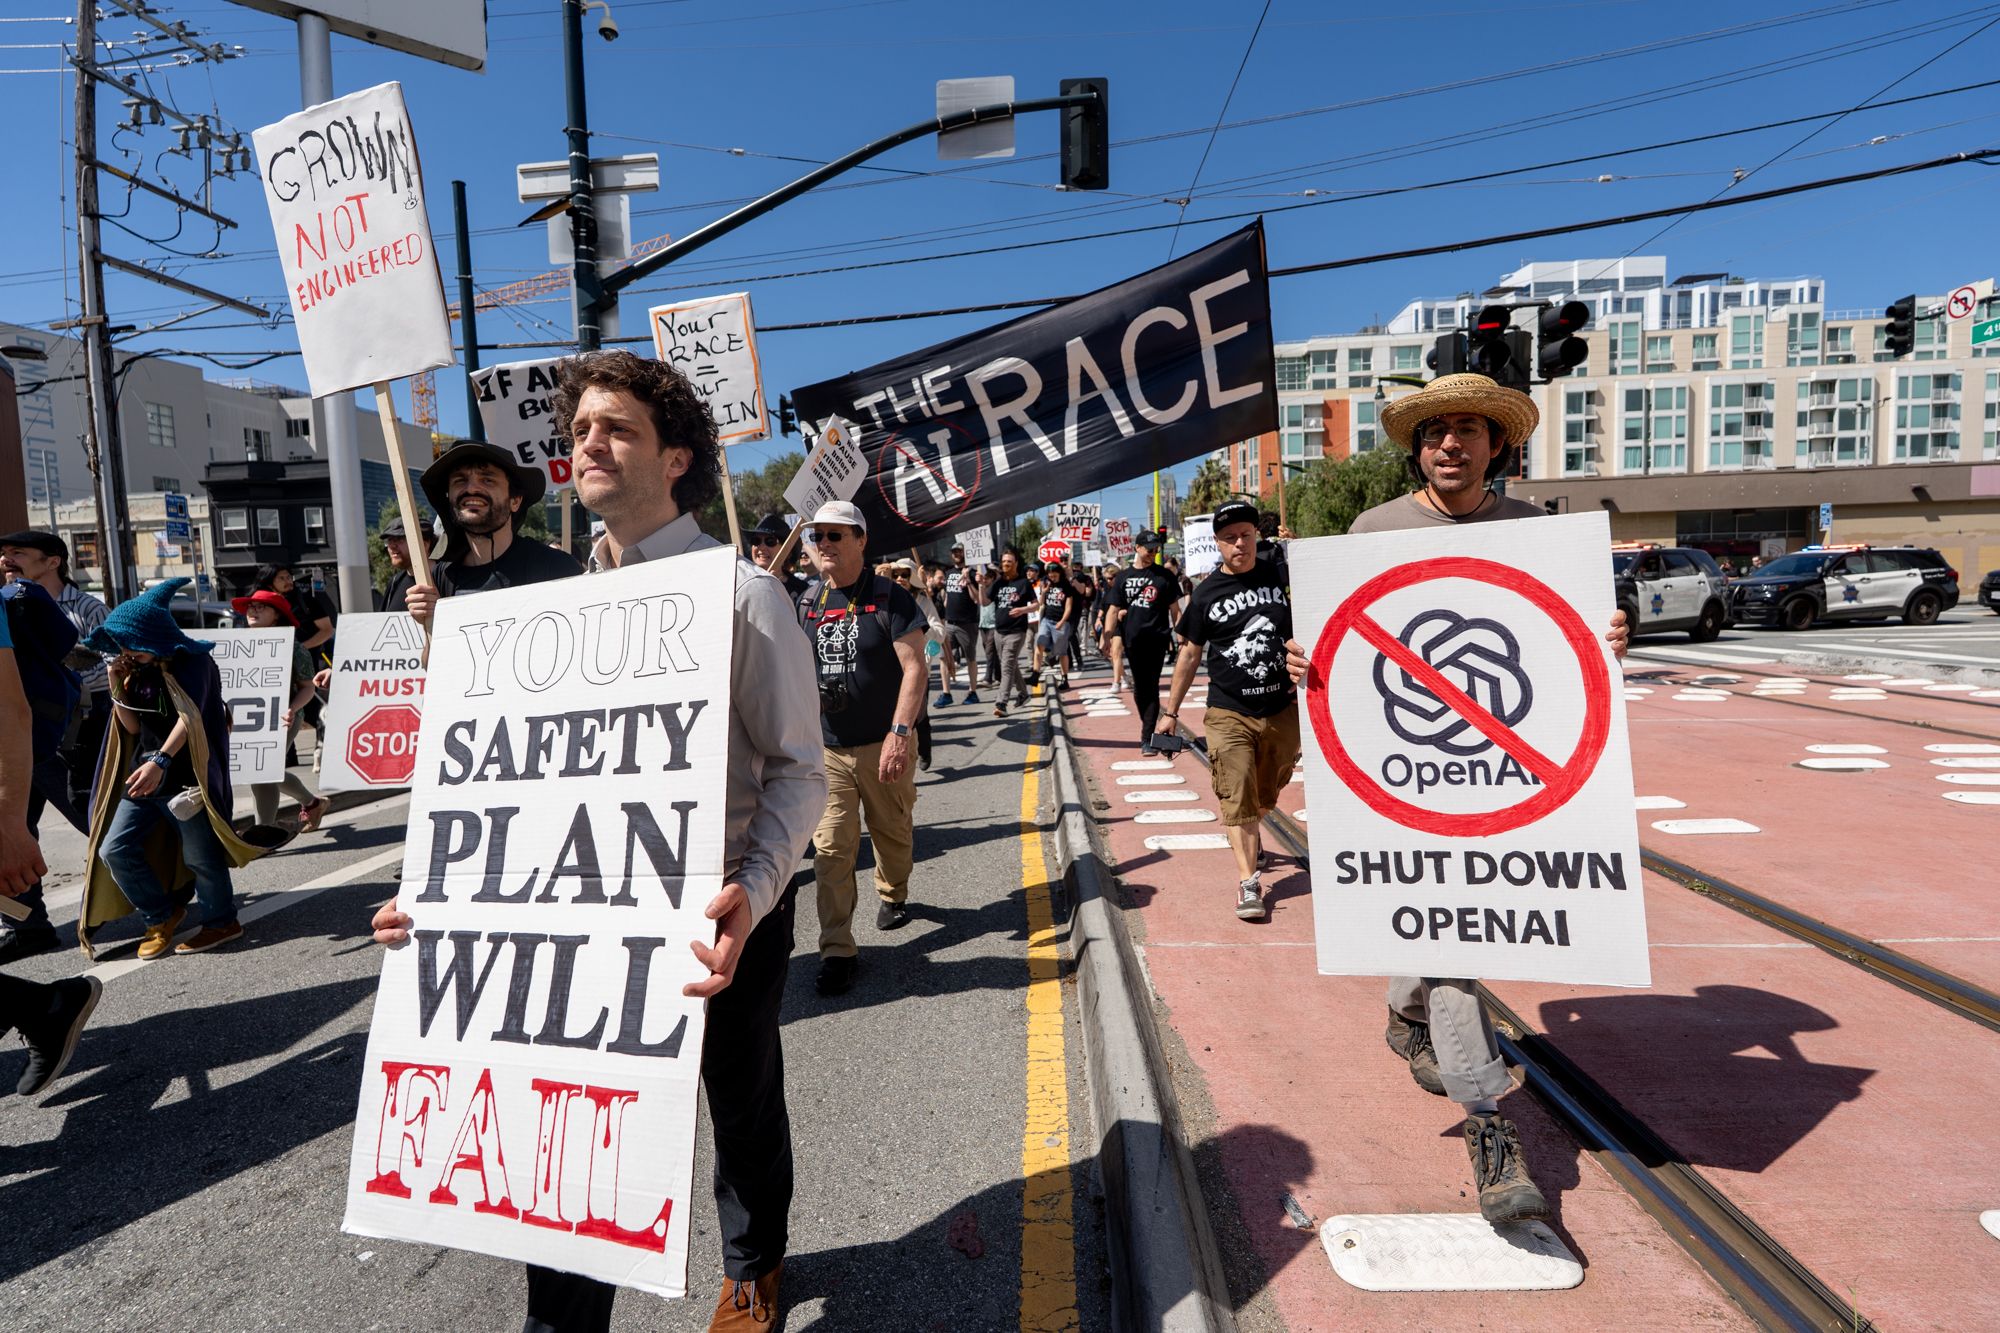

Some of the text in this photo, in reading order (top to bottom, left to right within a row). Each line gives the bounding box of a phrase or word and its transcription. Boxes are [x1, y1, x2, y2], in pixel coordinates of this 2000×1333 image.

[269, 111, 413, 201] GROWN
[295, 193, 369, 269] NOT
[296, 233, 422, 312] ENGINEERED
[659, 311, 728, 347] Your
[668, 333, 743, 368] RACE
[478, 369, 513, 402] IF
[964, 268, 1264, 476] RACE
[853, 364, 965, 428] THE
[16, 335, 62, 499] BNNETT LOFTS
[815, 456, 833, 479] Super
[819, 448, 845, 482] Artificial
[831, 449, 850, 476] before
[835, 439, 857, 470] PAUSE
[810, 464, 840, 501] Intelligen
[893, 427, 966, 516] AI
[816, 485, 829, 502] hits
[1057, 503, 1099, 516] I DON'T
[965, 529, 988, 541] DON'T
[1056, 517, 1085, 527] WANT
[1060, 526, 1092, 540] DIE
[1105, 520, 1129, 534] STOP
[971, 540, 983, 549] BE
[1109, 535, 1132, 550] RACING
[1118, 546, 1133, 555] NOW
[1187, 535, 1206, 546] DON'T
[1188, 544, 1219, 556] SKYN
[211, 638, 285, 659] ON'T
[459, 592, 699, 697] YOUR
[220, 667, 283, 688] AKE
[339, 657, 424, 672] ANTHRO
[359, 678, 426, 697] MUST
[1241, 683, 1281, 695] DEATH CULT
[227, 696, 280, 732] GI
[229, 741, 277, 771] ET
[438, 699, 708, 785] SAFETY
[416, 800, 698, 910] PLAN
[1335, 850, 1627, 890] SHUT DOWN
[1392, 905, 1571, 946] OPENAI
[413, 929, 689, 1058] WILL
[366, 1060, 673, 1254] FAIL
